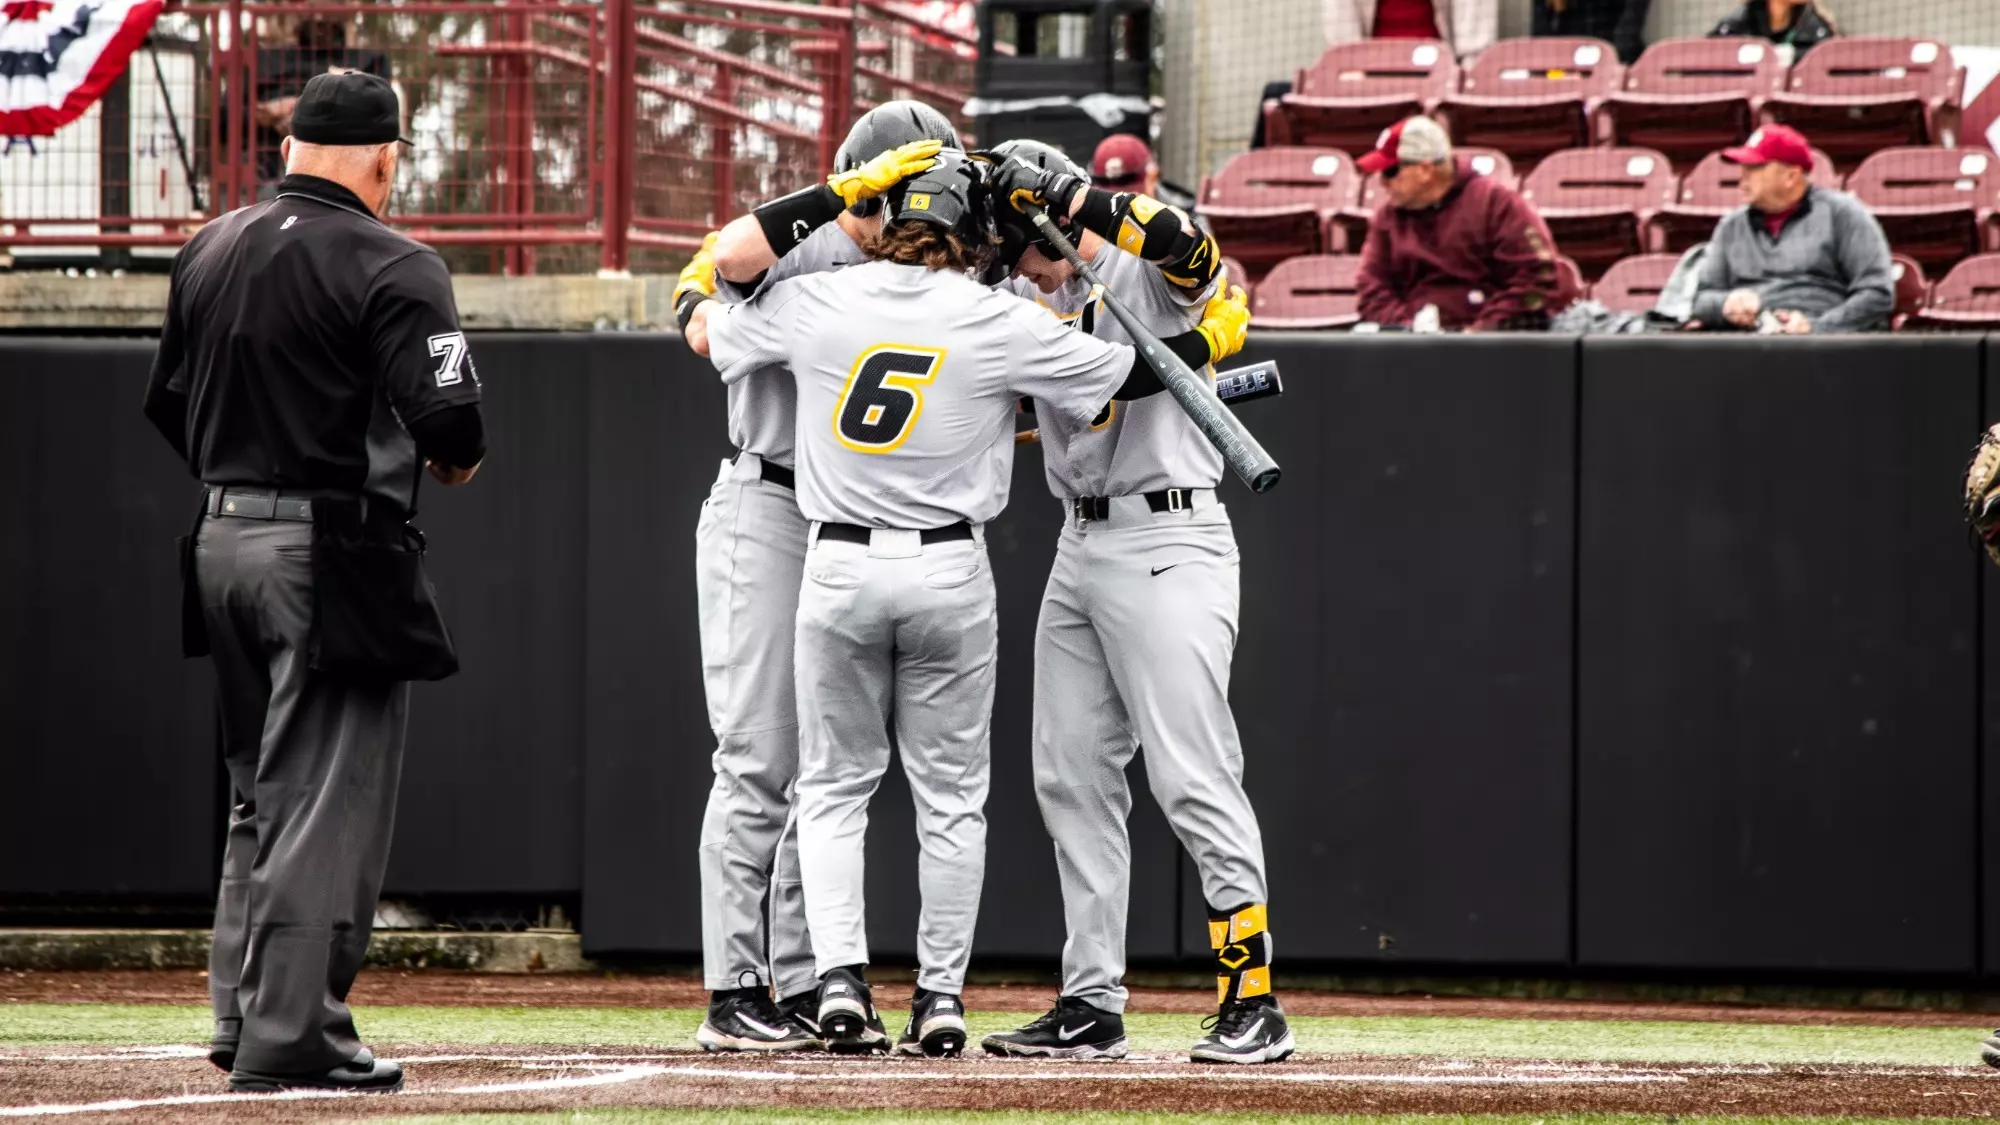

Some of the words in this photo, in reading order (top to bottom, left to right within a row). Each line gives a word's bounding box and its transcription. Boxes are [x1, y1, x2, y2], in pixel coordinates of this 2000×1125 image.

[426, 331, 481, 388] 7
[832, 342, 948, 455] 6
[1216, 370, 1270, 400] ILLE
[1165, 366, 1260, 480] LOUISVILLE
